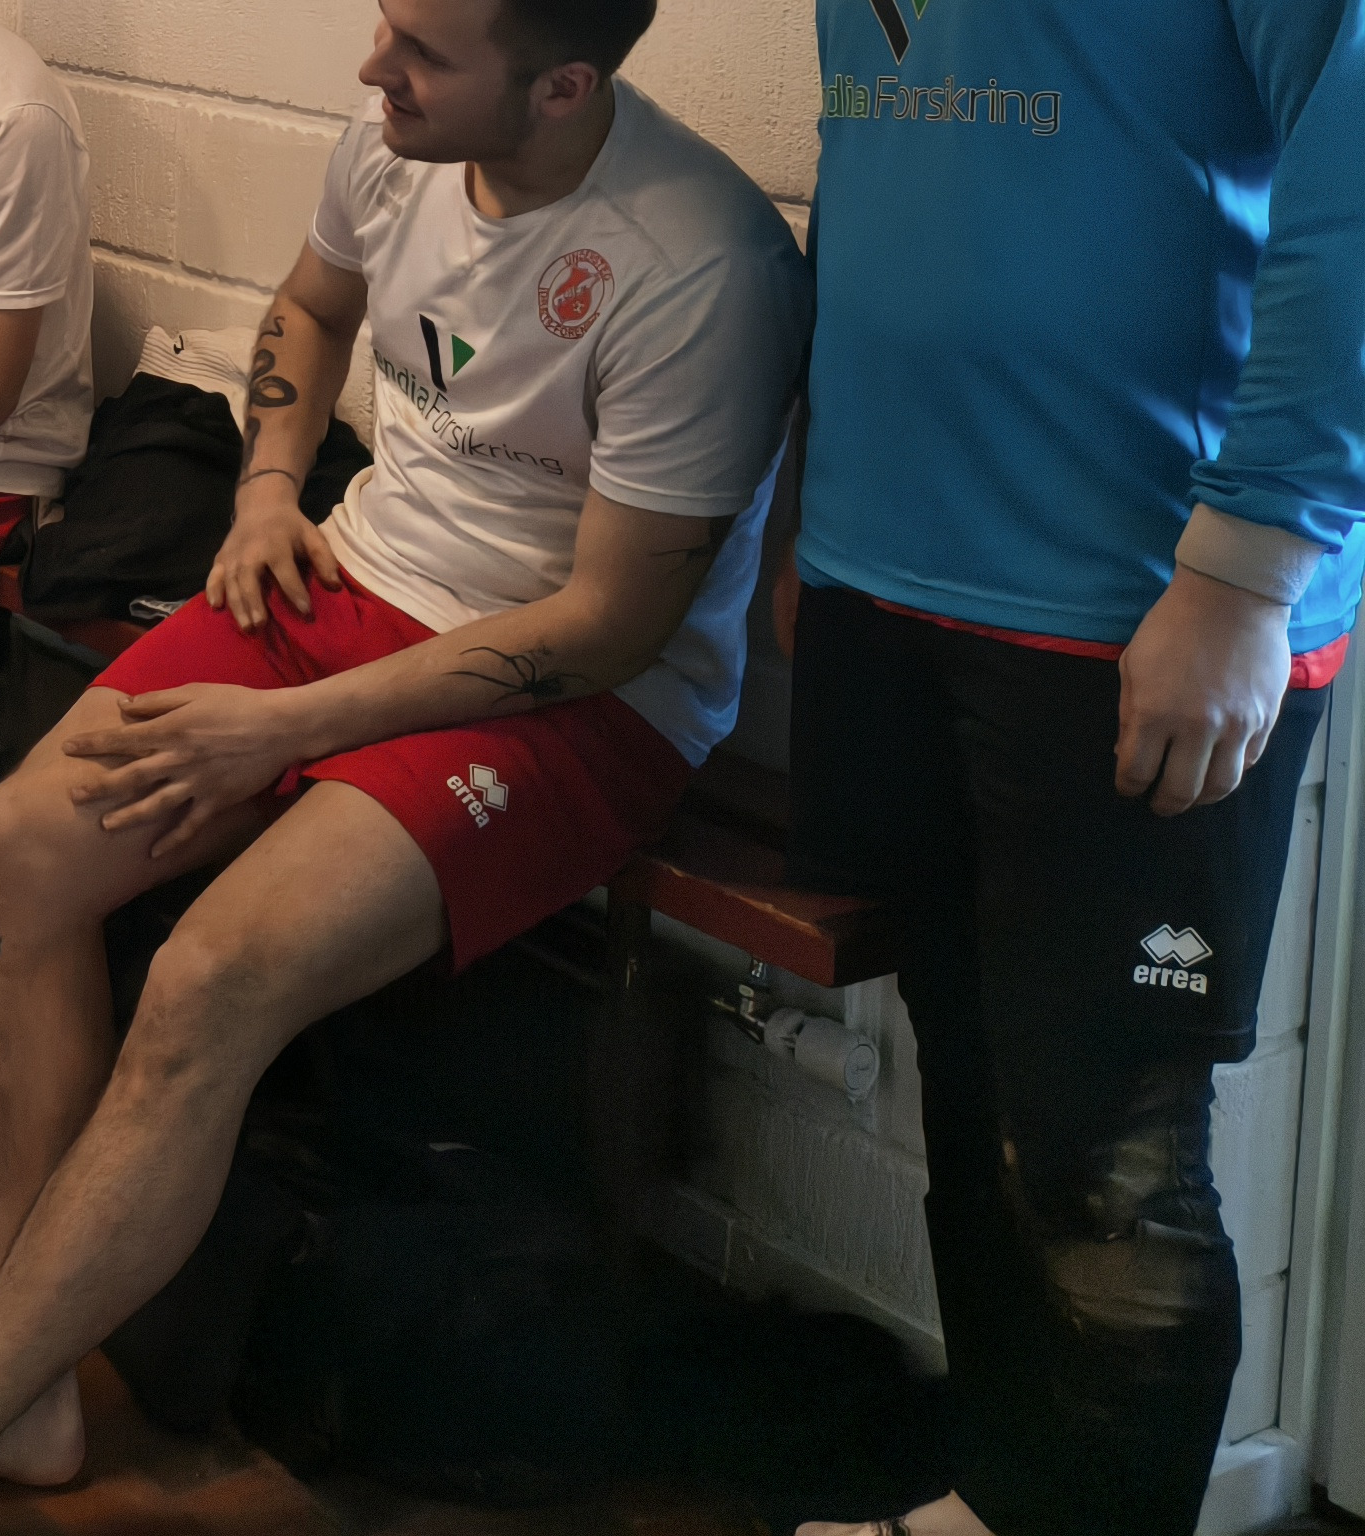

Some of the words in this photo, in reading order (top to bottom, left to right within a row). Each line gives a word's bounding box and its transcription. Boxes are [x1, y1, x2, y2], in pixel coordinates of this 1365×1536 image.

[373, 348, 564, 476] endiaForsikring
[446, 775, 490, 828] errea
[1133, 965, 1208, 995] errea
